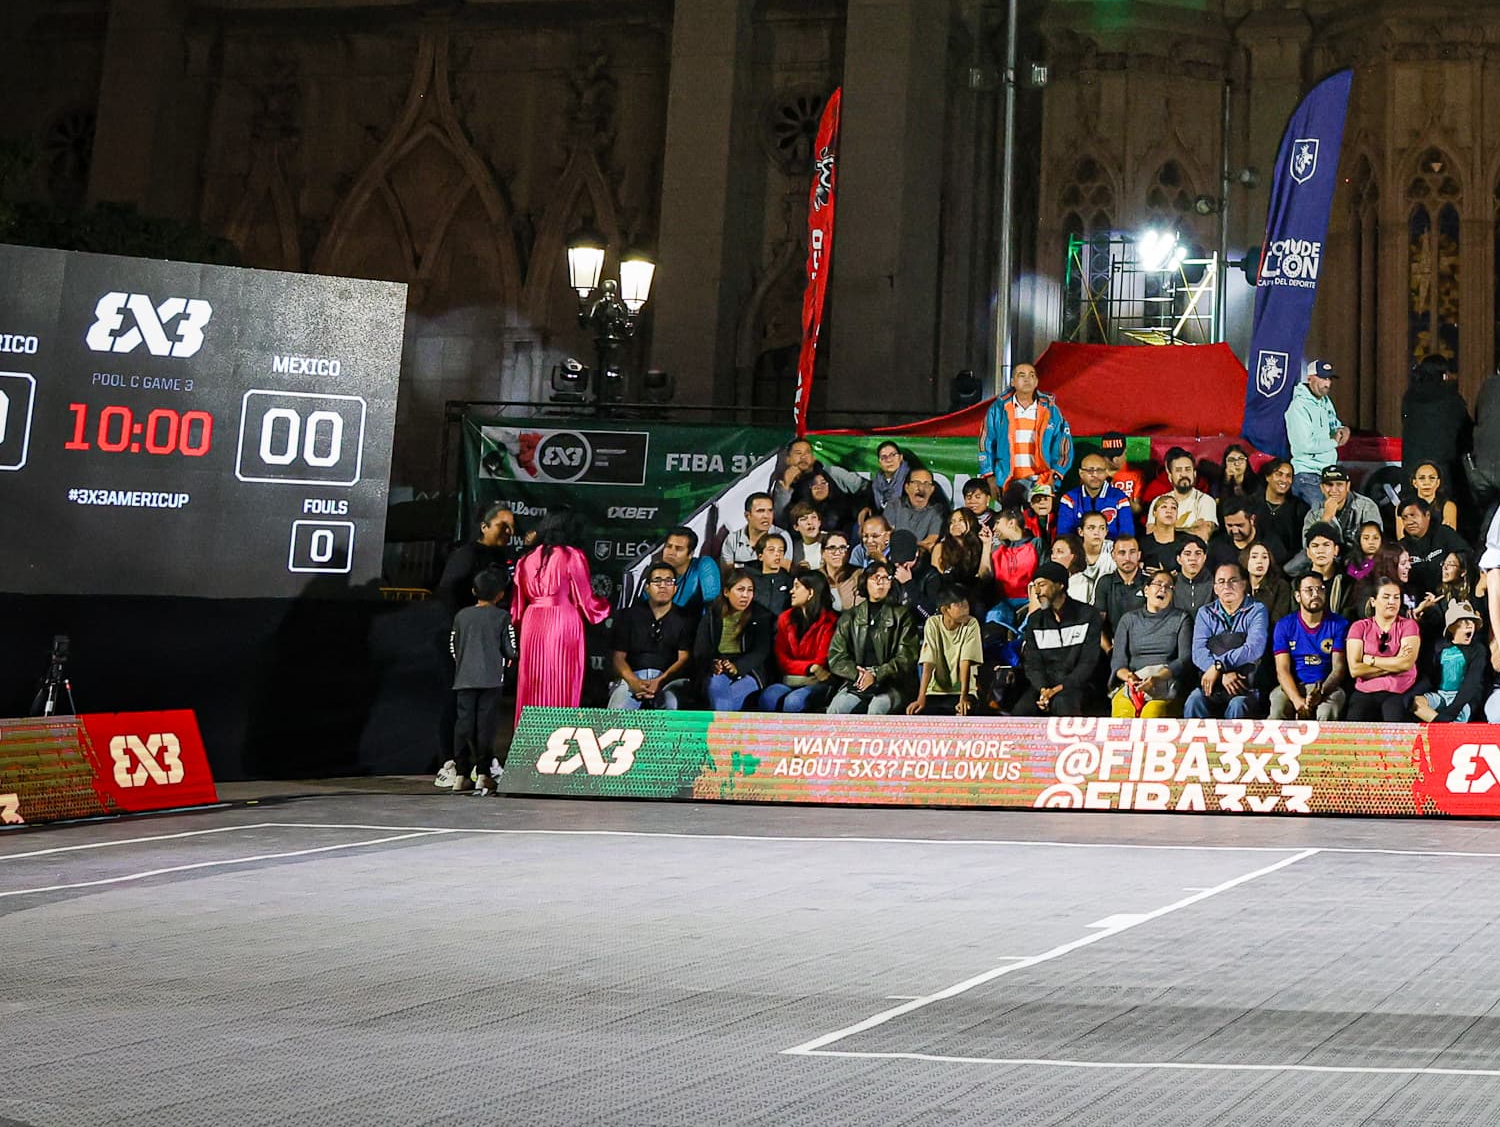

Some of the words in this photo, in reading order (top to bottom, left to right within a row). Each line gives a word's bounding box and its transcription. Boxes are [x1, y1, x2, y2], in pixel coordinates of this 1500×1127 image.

[273, 355, 341, 377] MEXICO
[92, 373, 127, 388] POOL
[130, 374, 140, 389] C
[142, 375, 182, 391] GAME
[184, 378, 194, 392] 3
[64, 403, 213, 457] 10:00
[259, 408, 343, 467] 00
[665, 453, 724, 472] FIBA
[68, 489, 189, 508] #3X3AMERICUP
[304, 498, 348, 515] FOULS
[310, 530, 334, 562] 0
[792, 737, 854, 759] WANT
[858, 738, 887, 759] TO
[890, 738, 953, 760] KNOW
[957, 738, 1012, 760] MORE
[774, 757, 846, 778] ABOUT
[847, 758, 897, 779] 3X3?
[900, 758, 990, 780] FOLLOW
[992, 759, 1022, 781] US
[1054, 741, 1302, 784] @FIBA3x3
